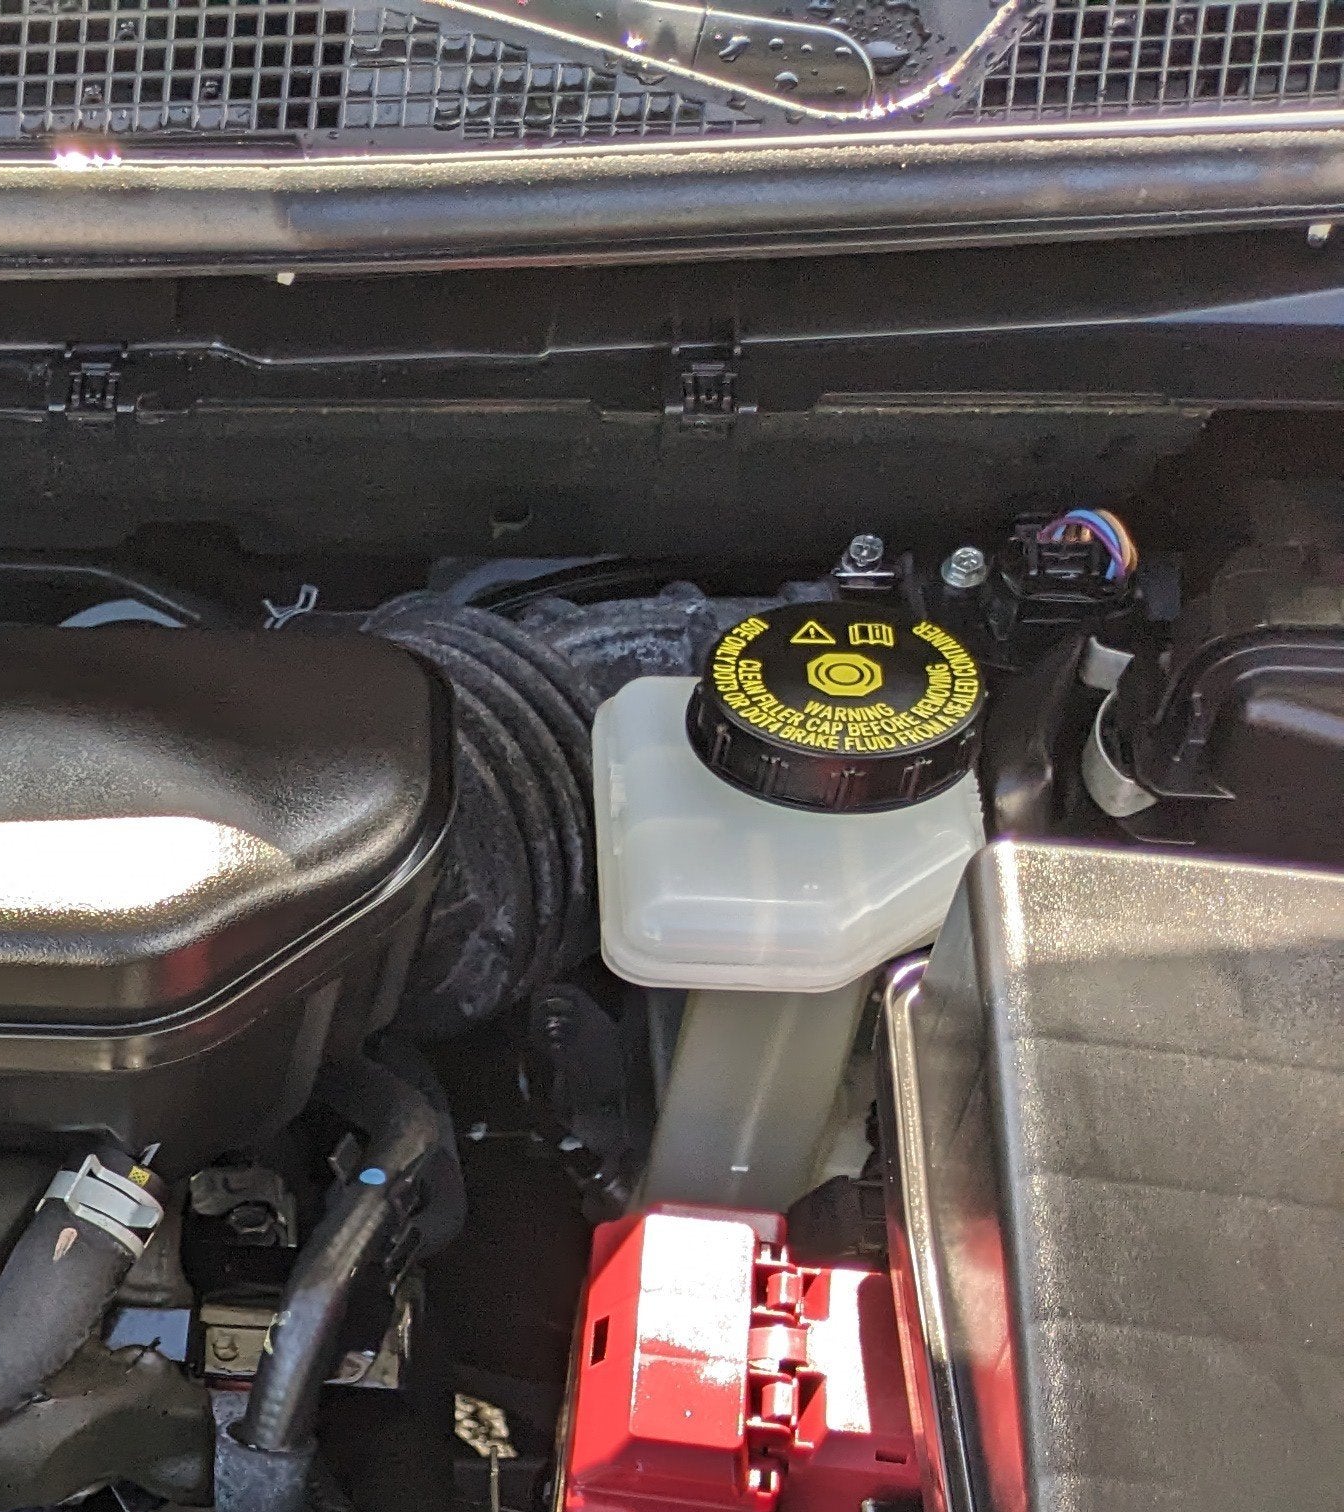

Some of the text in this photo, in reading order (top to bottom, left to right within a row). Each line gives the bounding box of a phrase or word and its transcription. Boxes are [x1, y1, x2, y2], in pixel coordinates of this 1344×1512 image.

[713, 617, 979, 751] USE ONLY DOT3 OR DOT4 BRAKE FLUID FROM A SEALED CONTAINER
[738, 659, 952, 737] CLEAN FILLER CAP BEFORE REMOVING
[803, 700, 895, 722] WARNING
